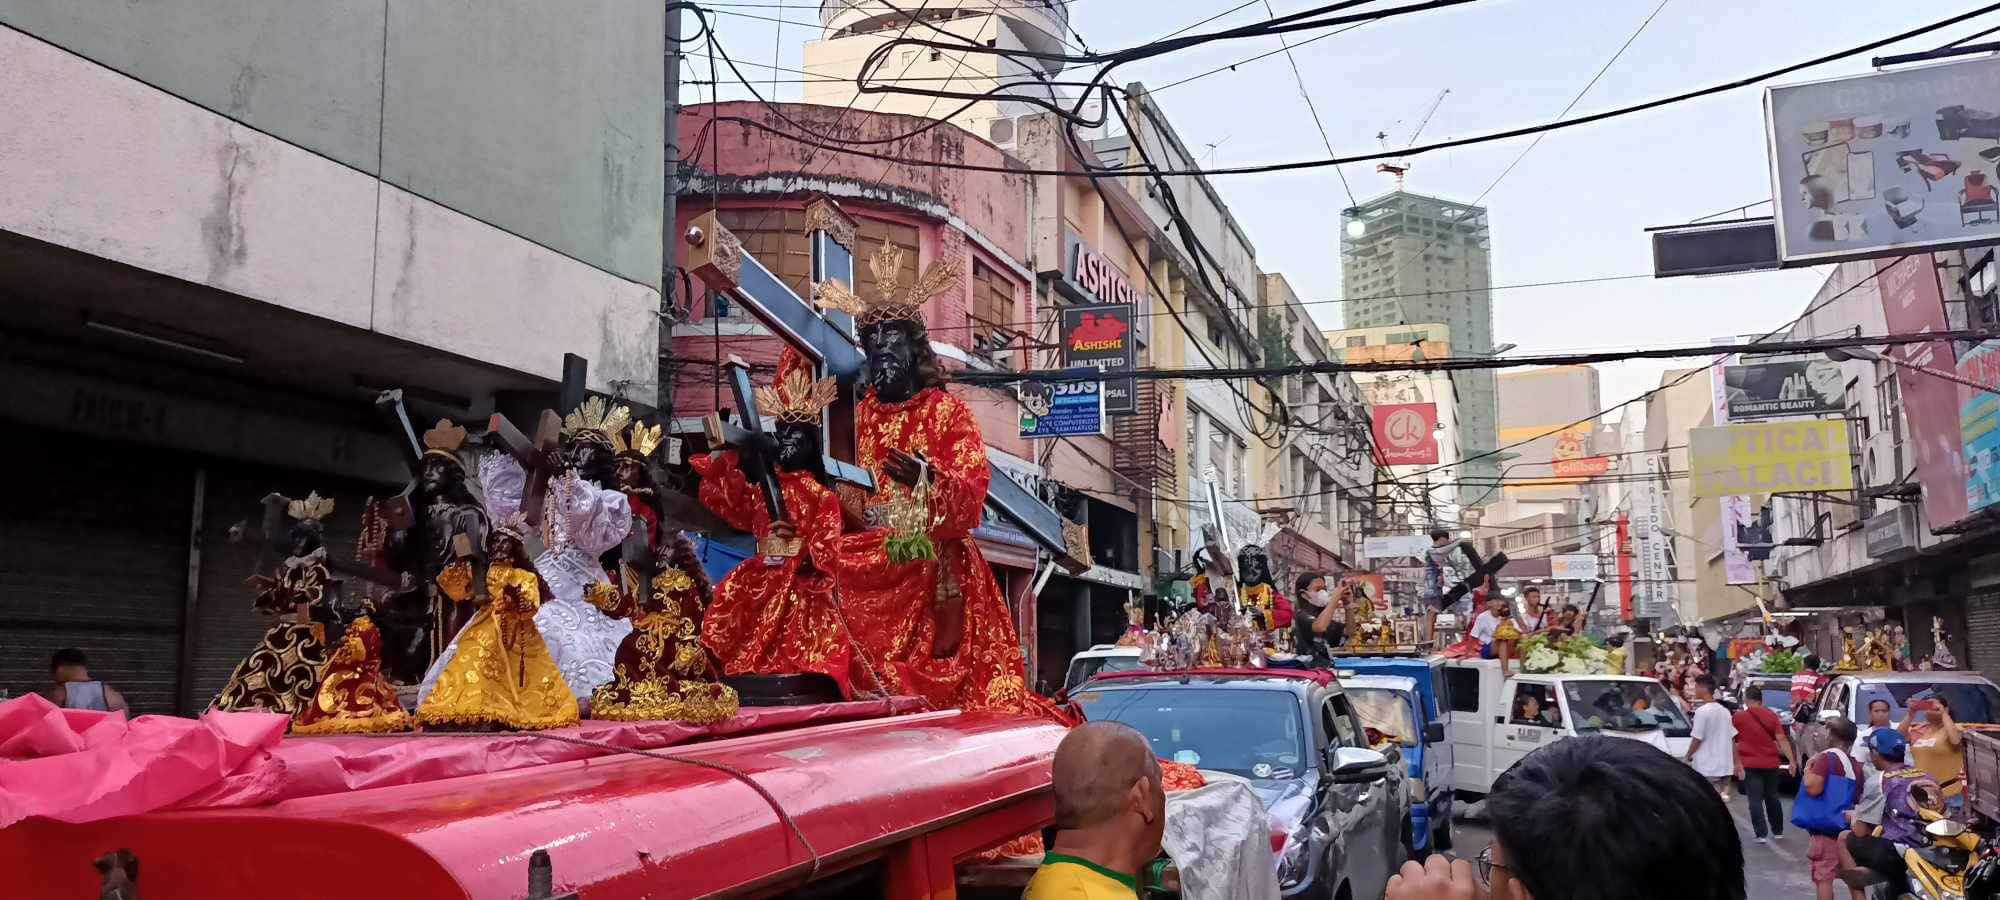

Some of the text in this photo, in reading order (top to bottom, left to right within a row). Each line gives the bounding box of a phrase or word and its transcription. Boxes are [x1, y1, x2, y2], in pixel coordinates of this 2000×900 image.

[1070, 357, 1125, 369] UNLIMITED
[1733, 399, 1816, 413] ROMANTIC BEAUTY
[1729, 426, 1844, 455] TICAL
